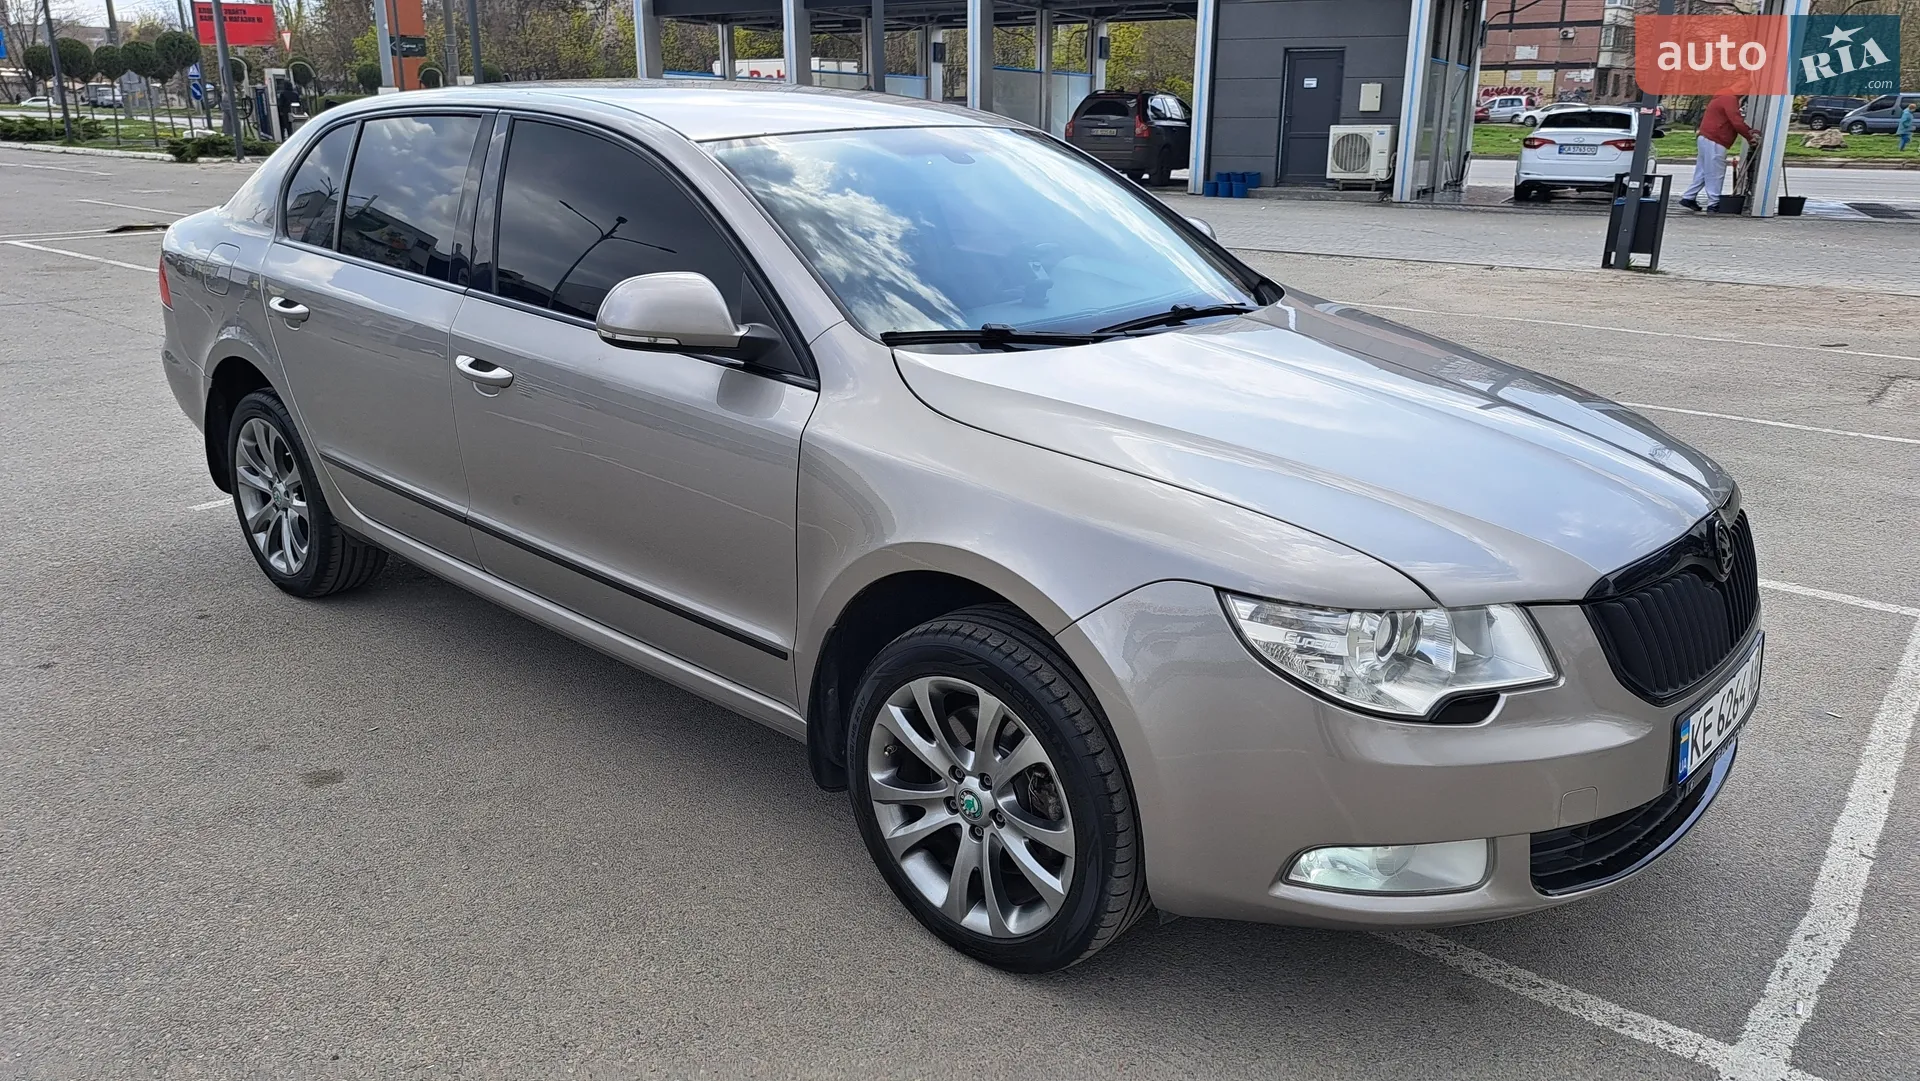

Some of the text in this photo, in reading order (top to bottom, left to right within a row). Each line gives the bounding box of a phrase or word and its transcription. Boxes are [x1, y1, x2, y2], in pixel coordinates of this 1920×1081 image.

[1284, 631, 1339, 650] Superb
[1690, 705, 1714, 767] KE
[1716, 670, 1747, 737] 6264
